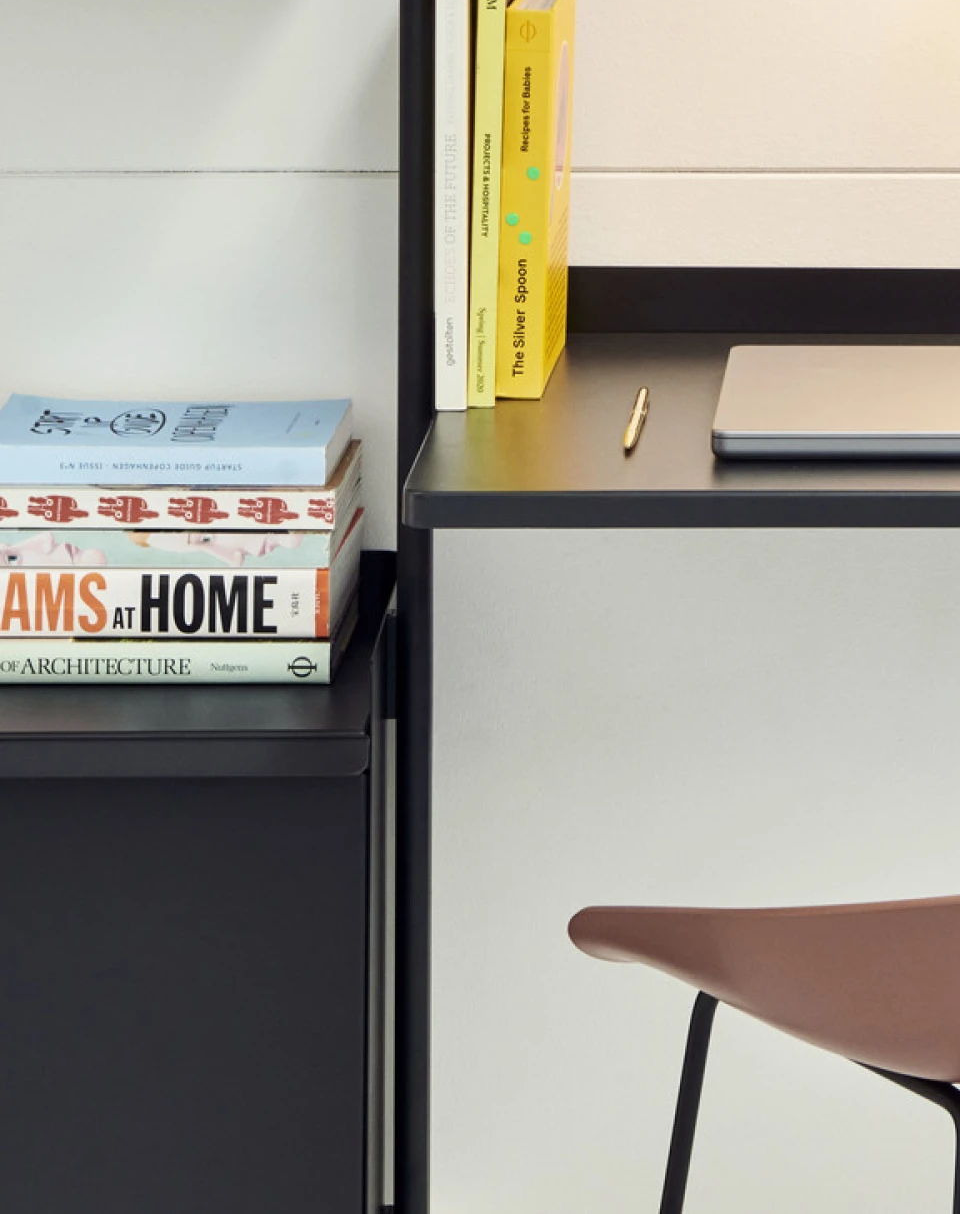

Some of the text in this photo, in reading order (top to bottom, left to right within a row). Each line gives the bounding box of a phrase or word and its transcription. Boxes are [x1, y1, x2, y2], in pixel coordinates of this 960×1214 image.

[520, 66, 532, 153] Recipes for Babies
[444, 134, 457, 191] FUTURE
[482, 133, 491, 175] PROJECTS
[444, 194, 457, 220] THE
[480, 184, 490, 238] HOSPITALITY
[444, 227, 457, 245] OF
[511, 258, 529, 377] The Silver Spoon
[78, 462, 103, 471] ISSUE
[112, 462, 171, 471] COPENHAGEN
[175, 462, 201, 471] GUIDE
[204, 462, 243, 471] STARTUP
[1, 572, 108, 634] AMS
[112, 606, 136, 630] AT
[140, 573, 278, 634] HOME
[20, 657, 191, 676] ARCHITECTURE
